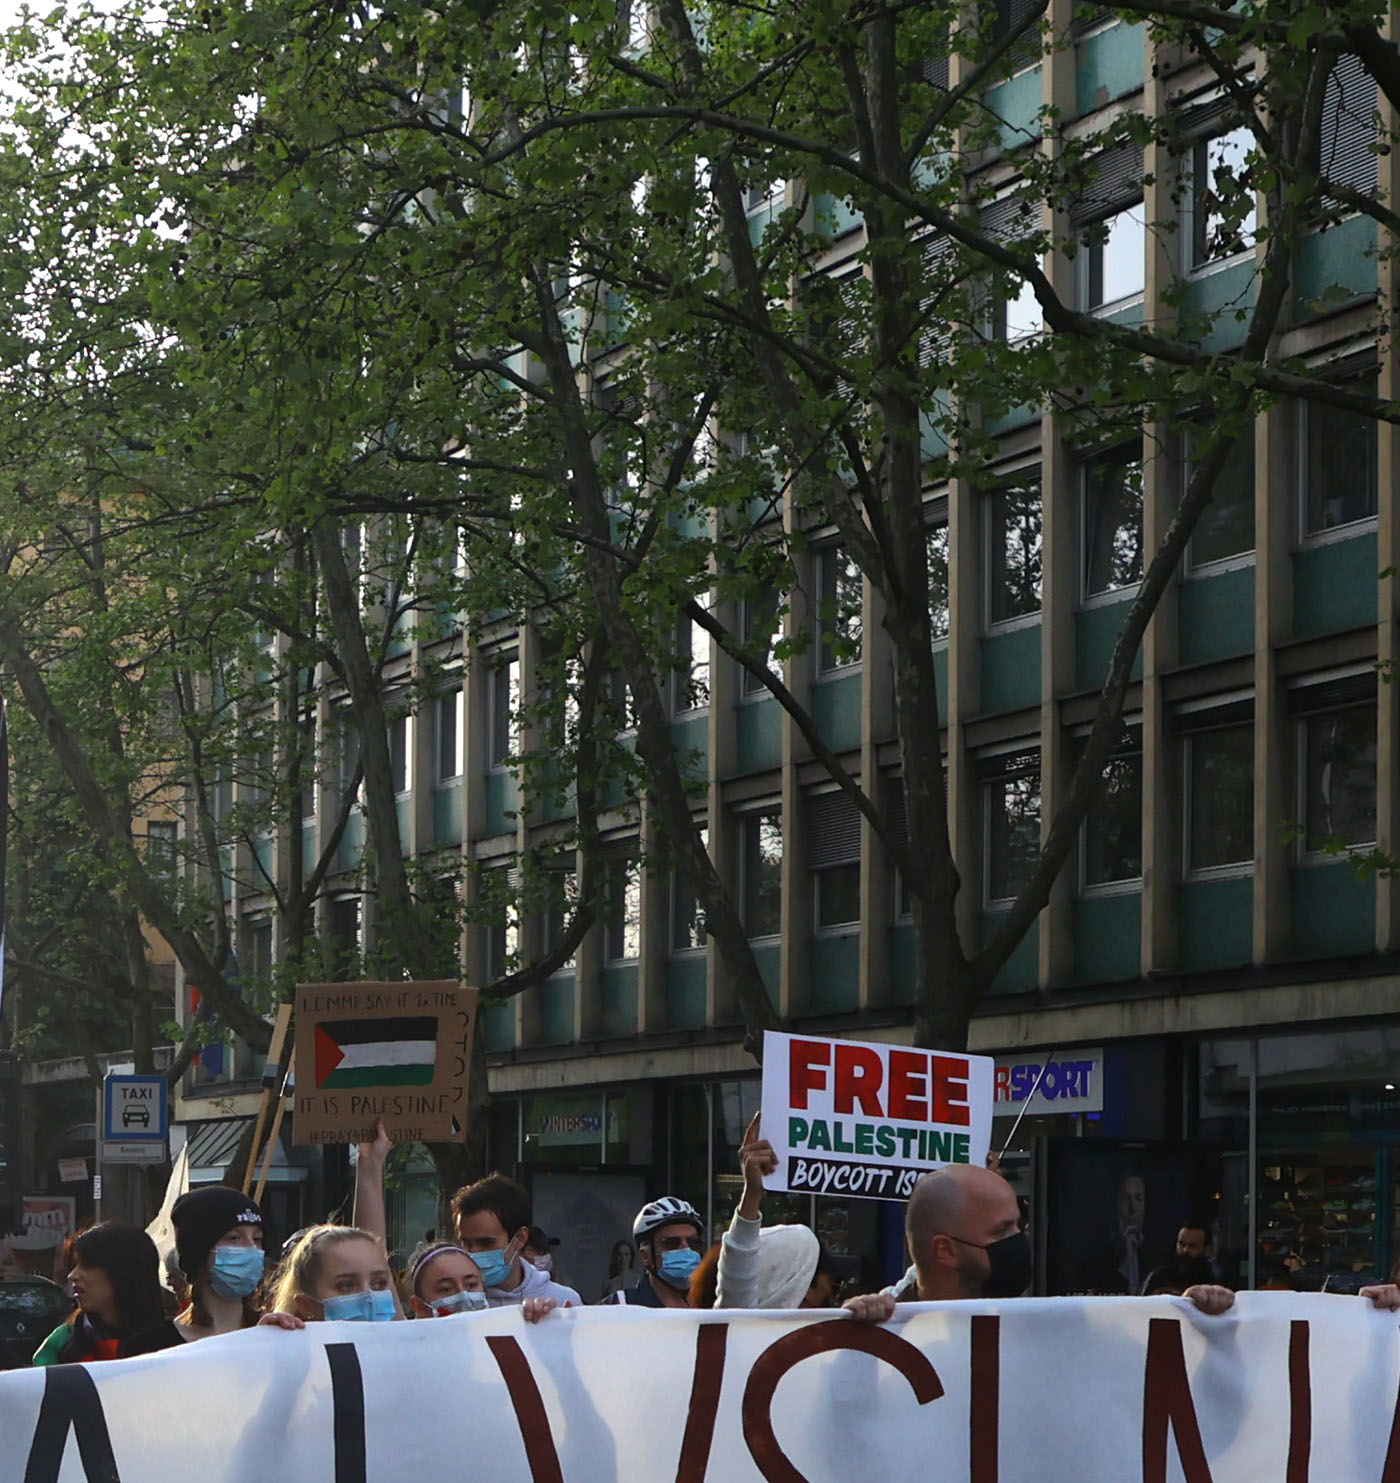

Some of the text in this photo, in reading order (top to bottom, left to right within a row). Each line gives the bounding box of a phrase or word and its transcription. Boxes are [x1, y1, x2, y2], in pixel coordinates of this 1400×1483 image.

[120, 1087, 153, 1100] TAXI
[789, 1038, 971, 1127] FREE
[300, 1096, 312, 1114] IT
[323, 1096, 338, 1114] IS
[788, 1116, 971, 1164] PALESTINE
[791, 1159, 894, 1194] BOYCOTT
